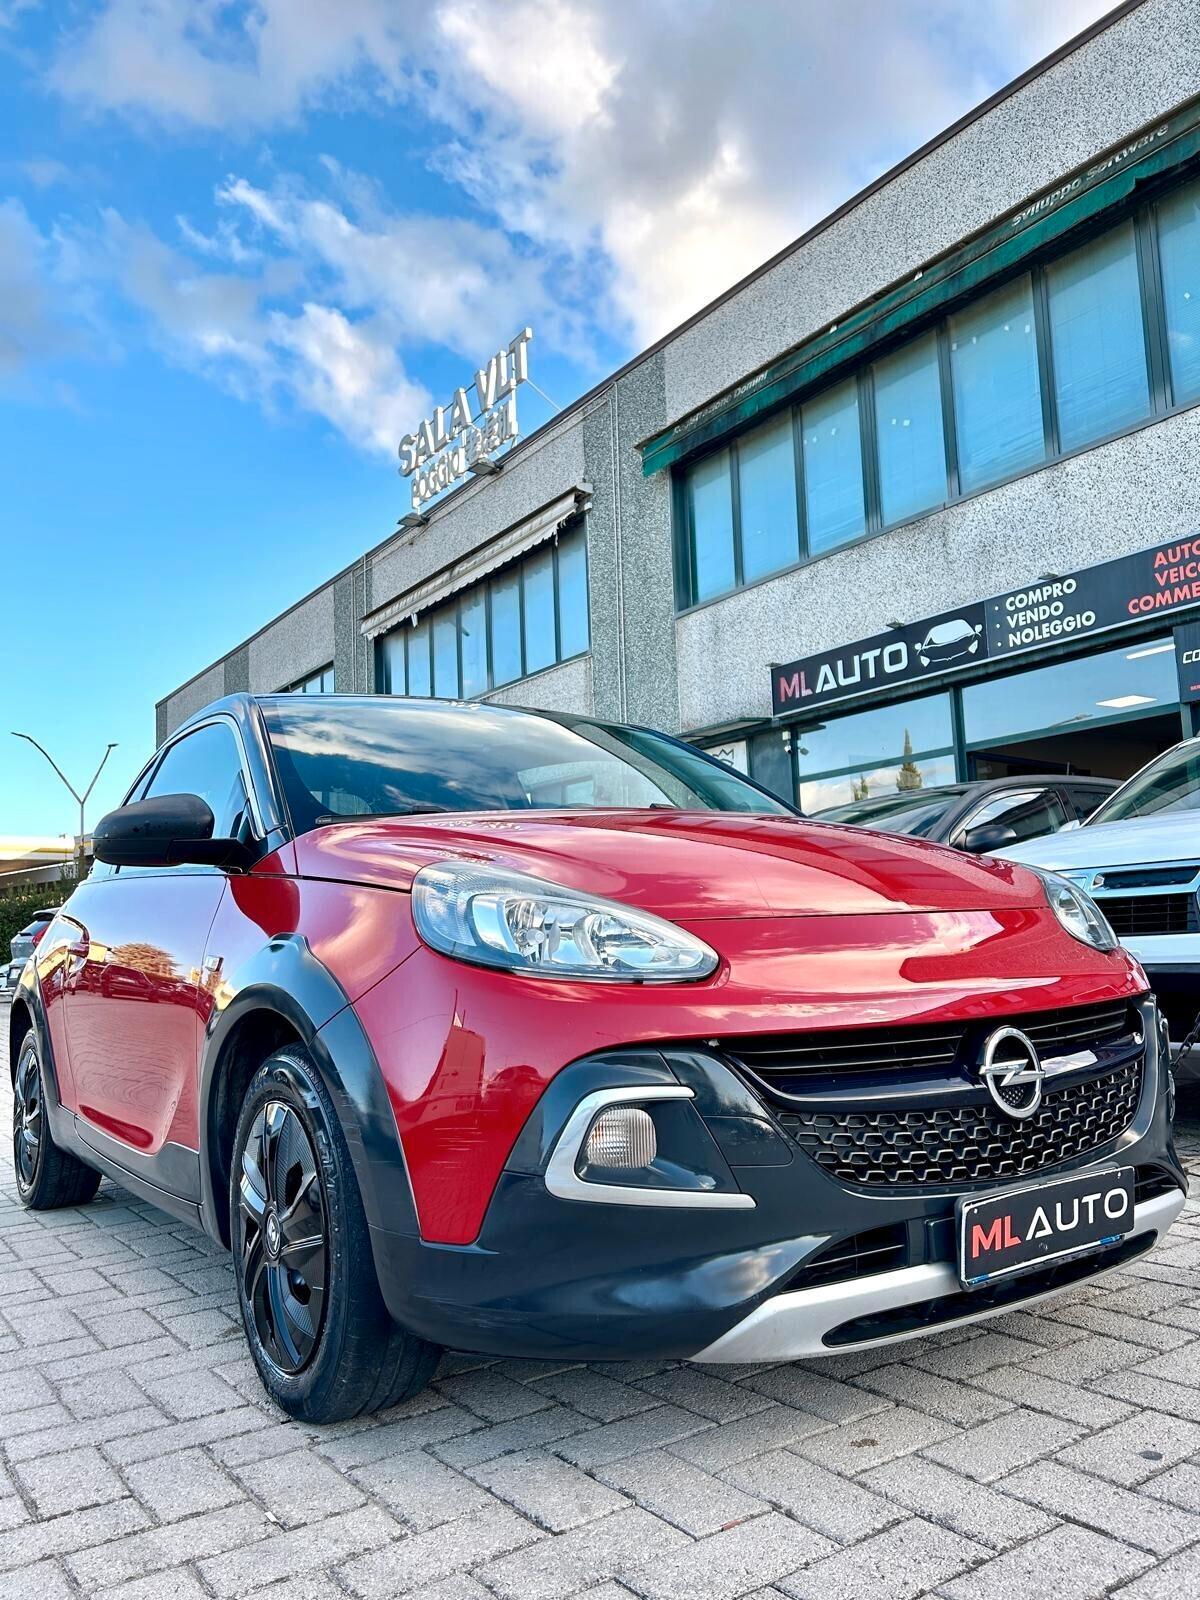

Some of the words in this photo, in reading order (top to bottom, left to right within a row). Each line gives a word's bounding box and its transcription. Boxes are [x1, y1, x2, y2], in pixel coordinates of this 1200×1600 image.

[398, 386, 473, 477] SALA
[474, 326, 533, 414] VLT
[1154, 561, 1200, 587] VEIC
[1005, 578, 1077, 611] COMPRO
[1127, 582, 1200, 615] COMME
[1007, 601, 1064, 629] VENDO
[1008, 610, 1096, 648] NOLEGGIO
[815, 641, 909, 694] AUTO
[972, 1215, 1022, 1259] ML
[1025, 1187, 1128, 1241] AUTO
